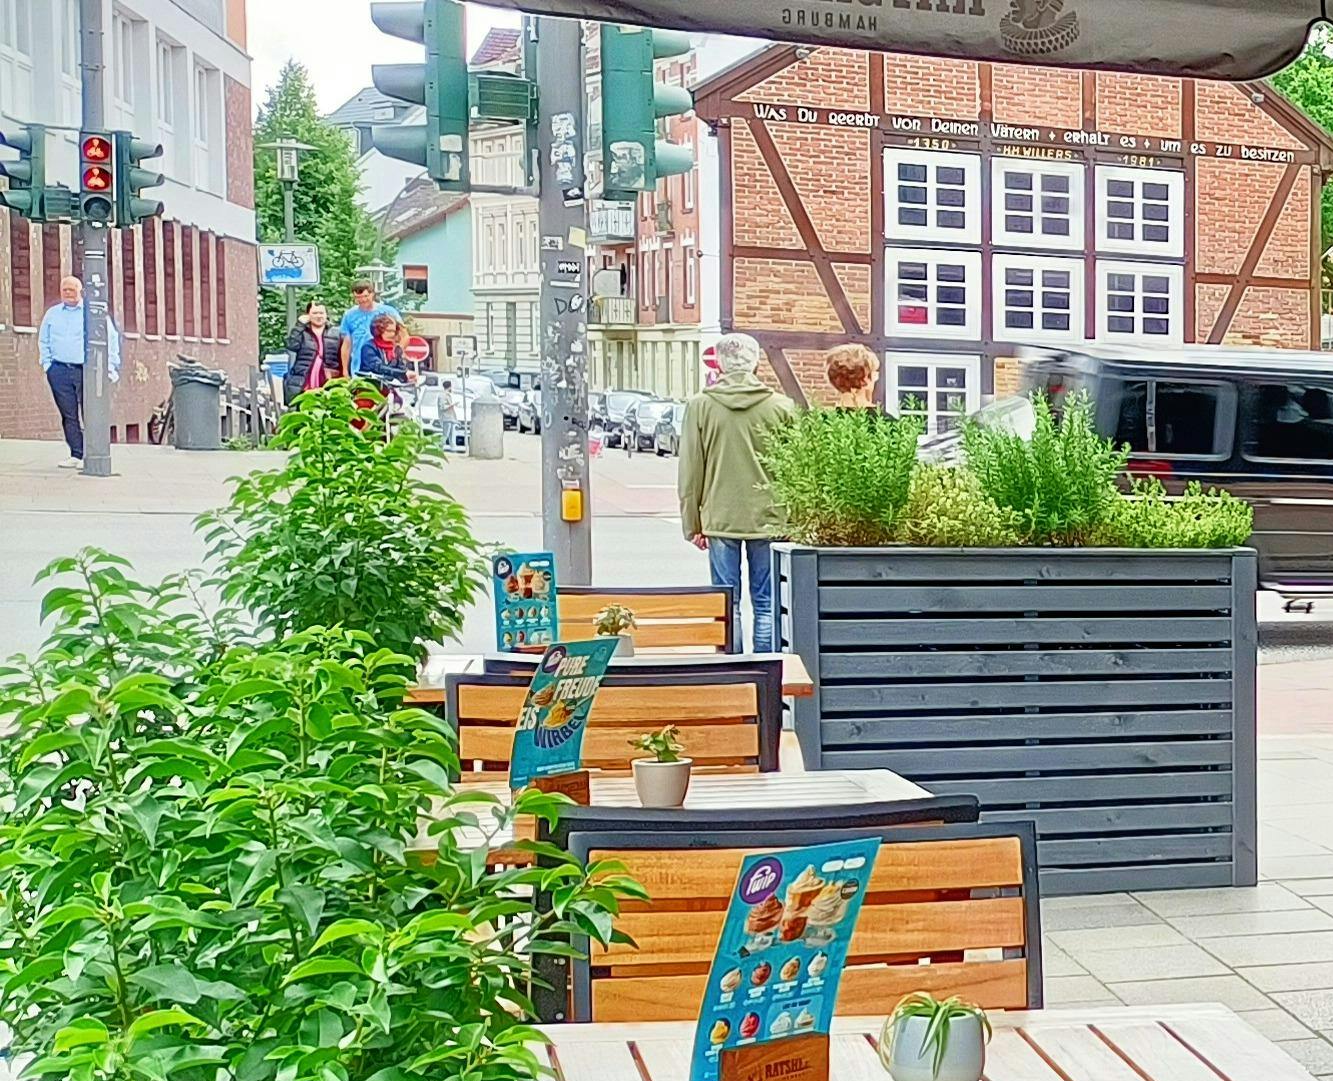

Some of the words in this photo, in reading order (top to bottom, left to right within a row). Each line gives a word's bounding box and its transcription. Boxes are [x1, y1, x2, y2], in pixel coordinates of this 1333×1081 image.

[1122, 155, 1155, 167] 1981
[554, 655, 590, 677] PURE
[518, 706, 539, 730] EIS
[534, 715, 586, 748] WIRBEL
